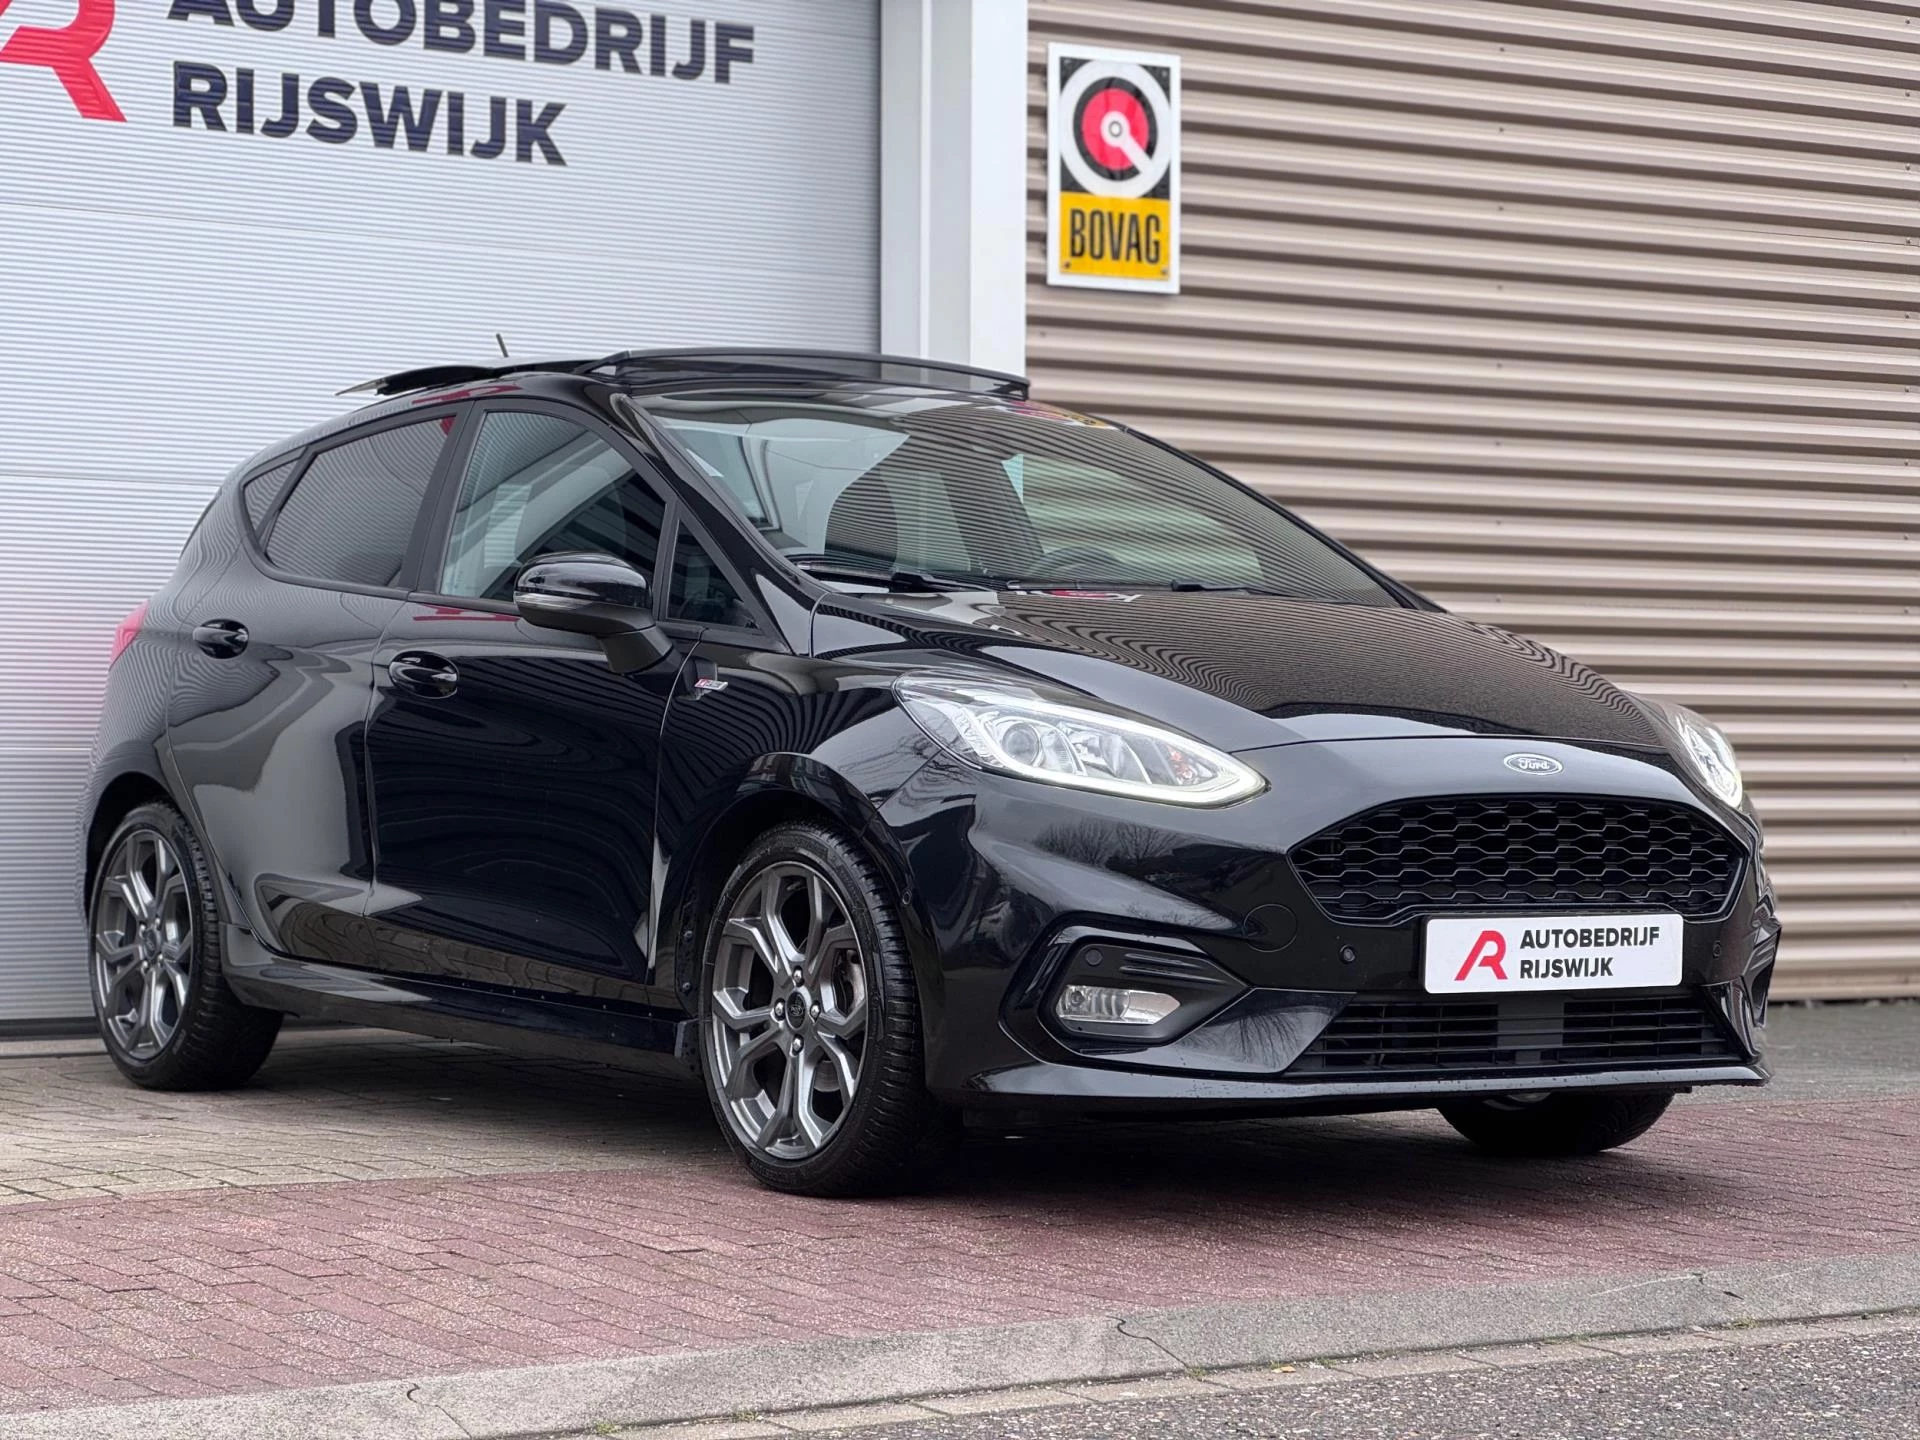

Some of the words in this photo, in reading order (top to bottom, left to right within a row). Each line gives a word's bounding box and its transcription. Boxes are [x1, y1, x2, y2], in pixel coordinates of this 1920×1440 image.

[173, 61, 567, 166] RIJSWIJK
[1069, 208, 1160, 265] BOVAG
[1518, 757, 1550, 770] Ford
[1520, 926, 1660, 949] AUTOBEDRIJF
[1520, 957, 1613, 979] RIJSWIJK
